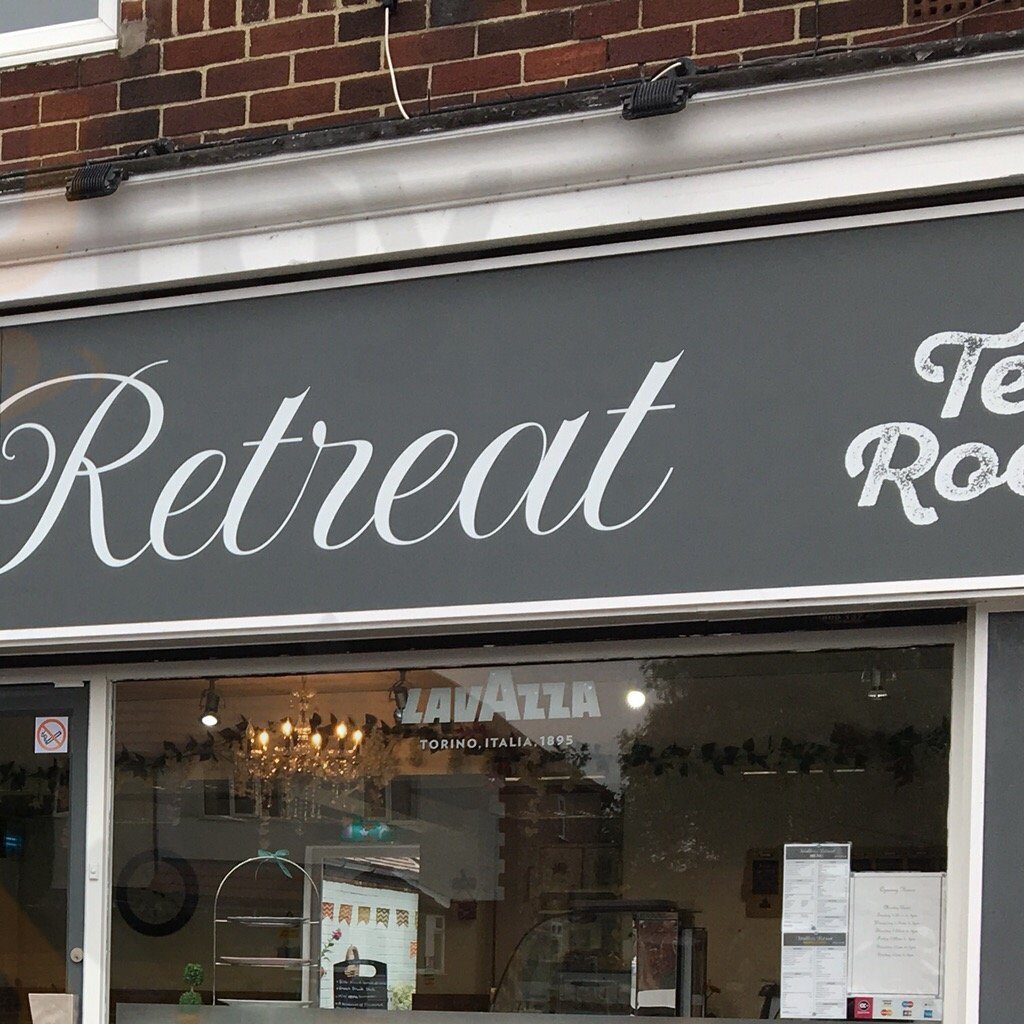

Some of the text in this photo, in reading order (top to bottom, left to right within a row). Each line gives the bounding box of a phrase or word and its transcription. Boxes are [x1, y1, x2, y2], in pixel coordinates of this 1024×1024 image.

[844, 421, 1024, 526] Ro
[401, 669, 602, 724] LAVAZZA
[539, 734, 574, 746] 1895
